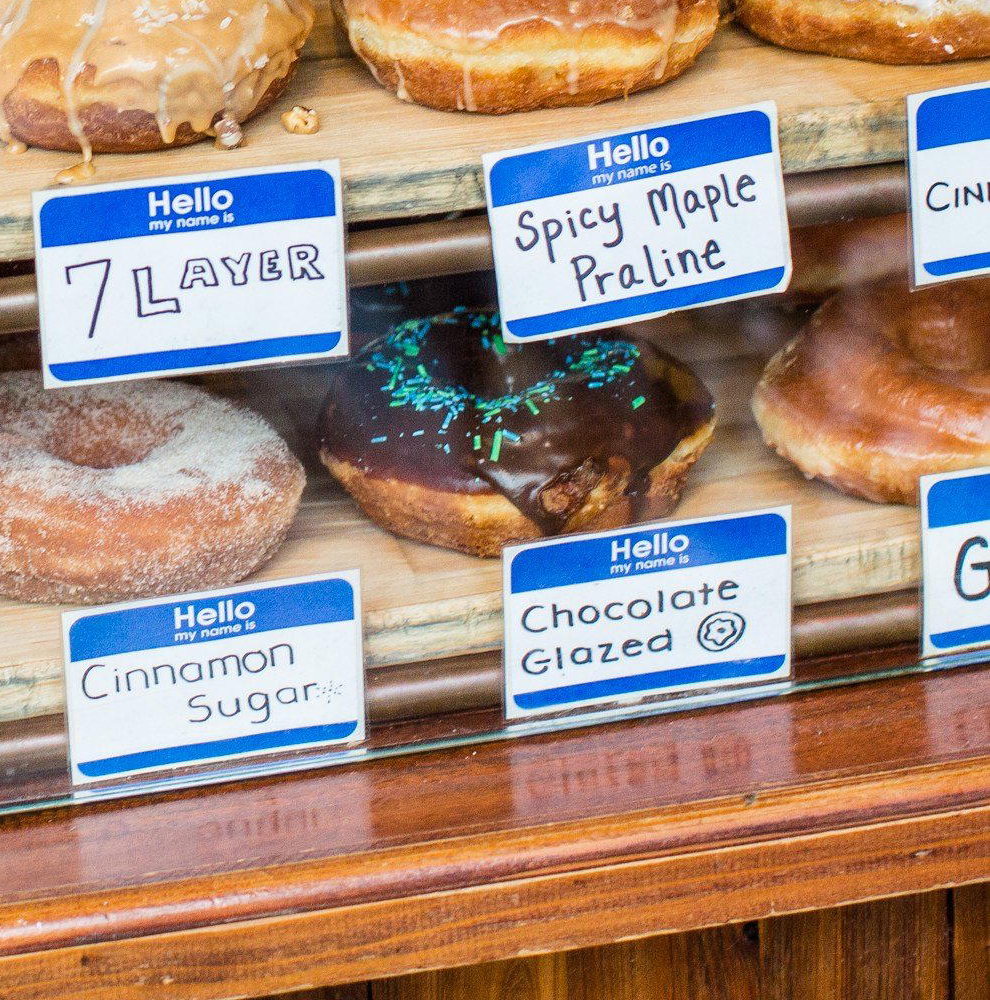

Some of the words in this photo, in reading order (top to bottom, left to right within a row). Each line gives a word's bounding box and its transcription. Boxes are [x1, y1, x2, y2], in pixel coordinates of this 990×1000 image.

[587, 133, 670, 170] Hello
[592, 171, 615, 186] my
[617, 163, 658, 181] name
[659, 159, 672, 172] is
[148, 186, 234, 217] Hello
[925, 181, 990, 212] CIN
[149, 218, 172, 231] my
[176, 214, 219, 229] name
[222, 211, 234, 223] is
[514, 201, 624, 263] Spicy
[647, 173, 757, 229] Maple
[570, 239, 725, 302] Praline
[65, 258, 111, 339] 7
[131, 244, 324, 318] LAYER
[610, 532, 690, 562] Hello
[610, 562, 632, 575] my
[635, 557, 674, 571] name
[678, 553, 690, 565] is
[173, 599, 256, 630] Hello
[521, 579, 740, 633] Chocolate
[174, 630, 197, 643] my
[200, 624, 241, 638] name
[244, 620, 256, 632] is
[521, 629, 673, 675] Glazed
[81, 643, 294, 700] Cinnamon
[188, 681, 317, 724] Sugar
